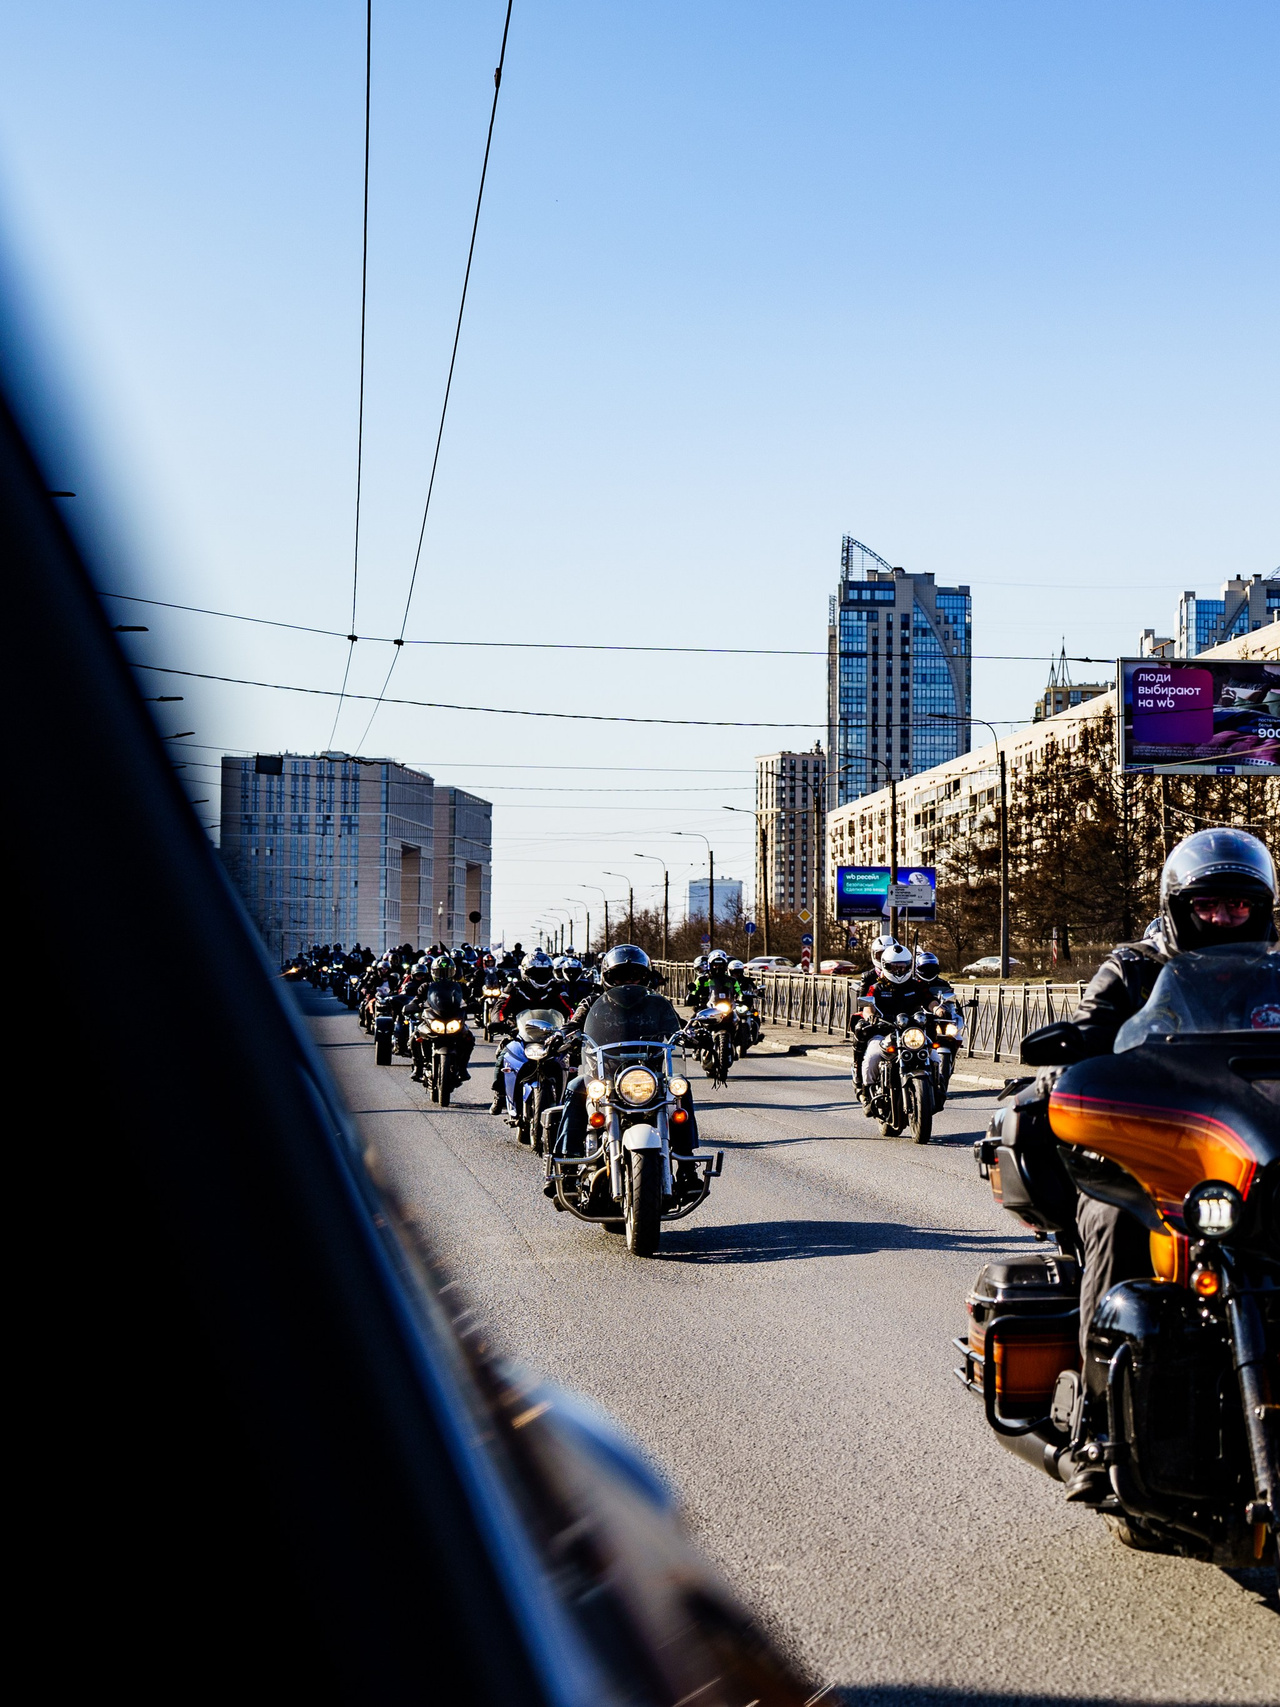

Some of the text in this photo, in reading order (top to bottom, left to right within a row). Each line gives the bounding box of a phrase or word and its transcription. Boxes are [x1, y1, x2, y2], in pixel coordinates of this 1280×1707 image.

[1138, 673, 1171, 683] люди
[1138, 684, 1201, 697] выбирают
[1138, 697, 1175, 708] на wb
